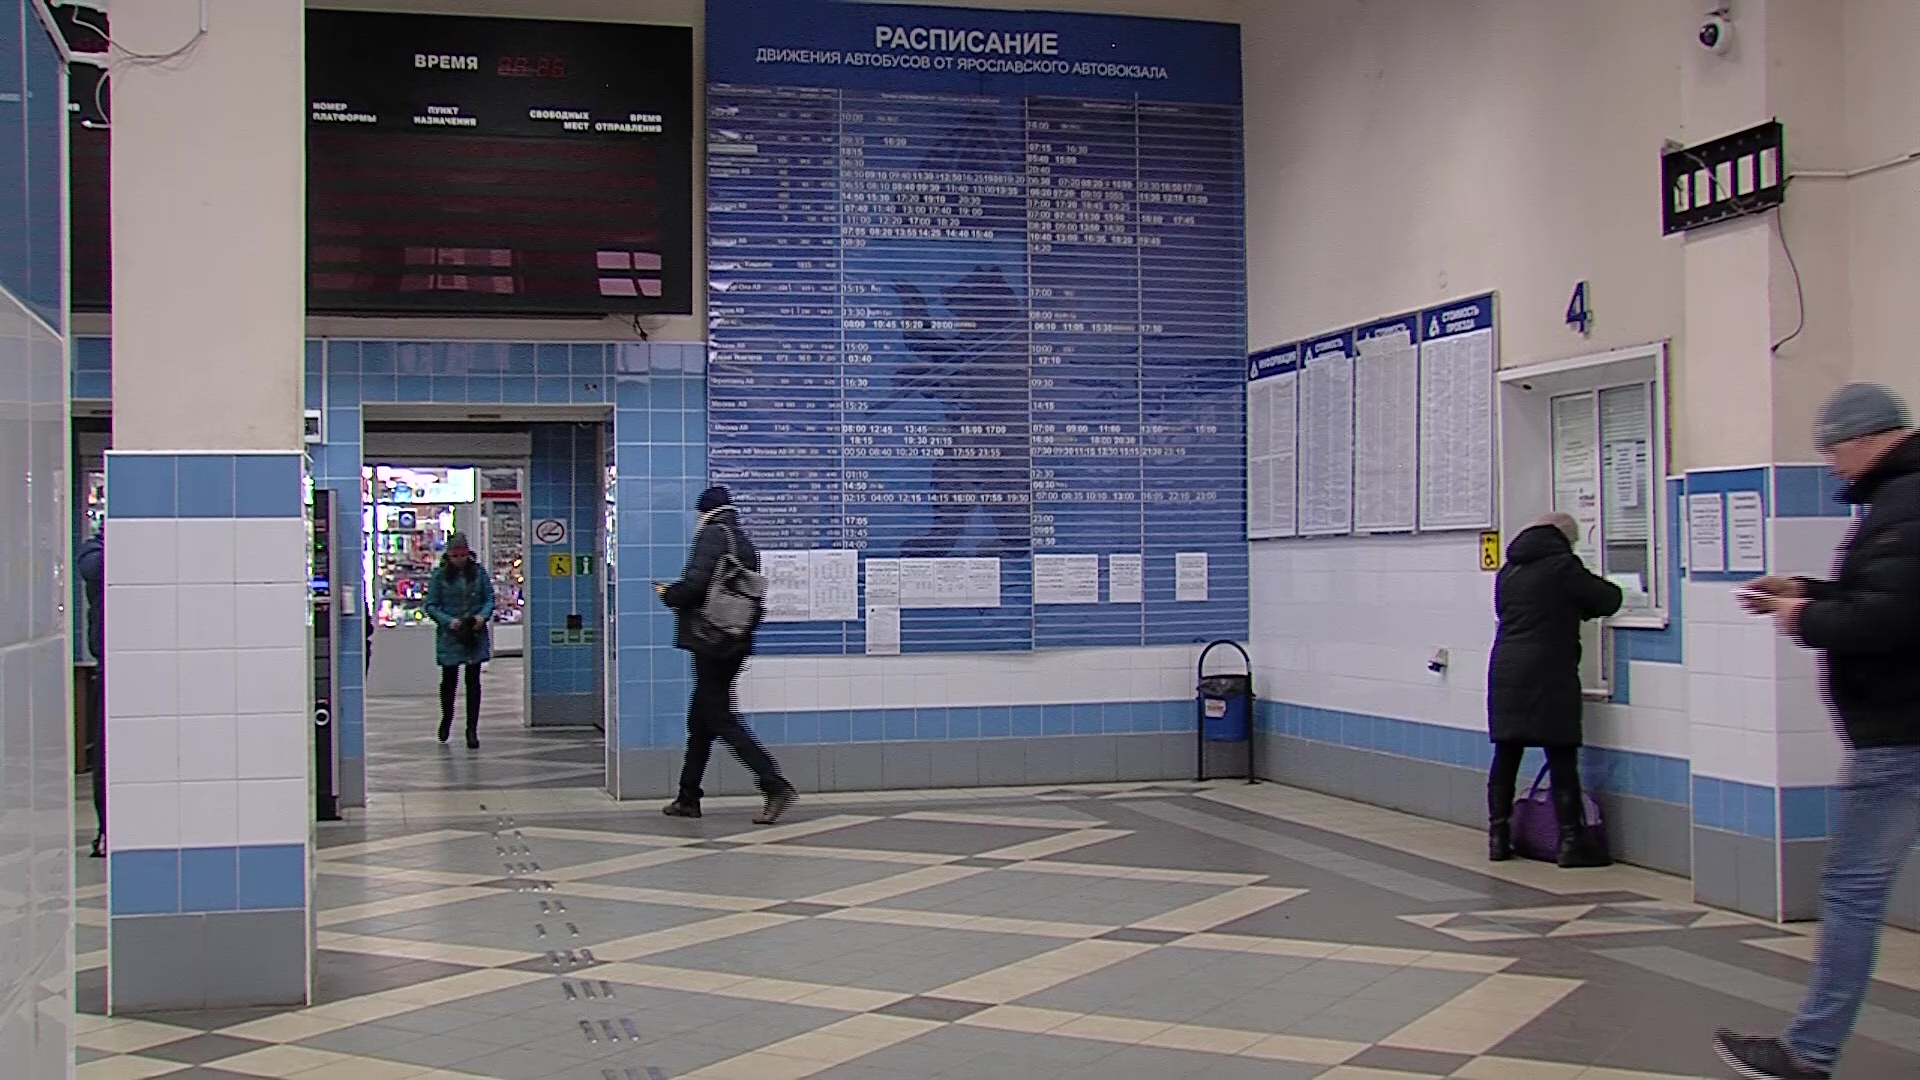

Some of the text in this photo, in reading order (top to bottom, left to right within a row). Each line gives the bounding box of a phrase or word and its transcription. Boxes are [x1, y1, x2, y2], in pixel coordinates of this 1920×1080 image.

[876, 26, 1059, 55] РАСПИСАНИЕ
[414, 54, 479, 71] ВРЕМЯ
[756, 47, 1168, 79] ДВИЖЕНИЯ АВТОБУСОВ ОТ ЯРОСЛАВСКОГО АВТОВОКЗАЛА
[427, 105, 459, 116] ПУНКТ
[529, 109, 590, 121] СВОБОДНЫХ
[312, 112, 378, 124] ПЛАТФОРМЫ
[413, 115, 477, 128] НАЗНАЧЕНИЯ
[629, 113, 663, 124] ВРЕМЯ
[563, 121, 590, 132] МЕСТ
[594, 122, 663, 134] ОТПРАВЛЕНИЯ
[1566, 281, 1590, 333] 4
